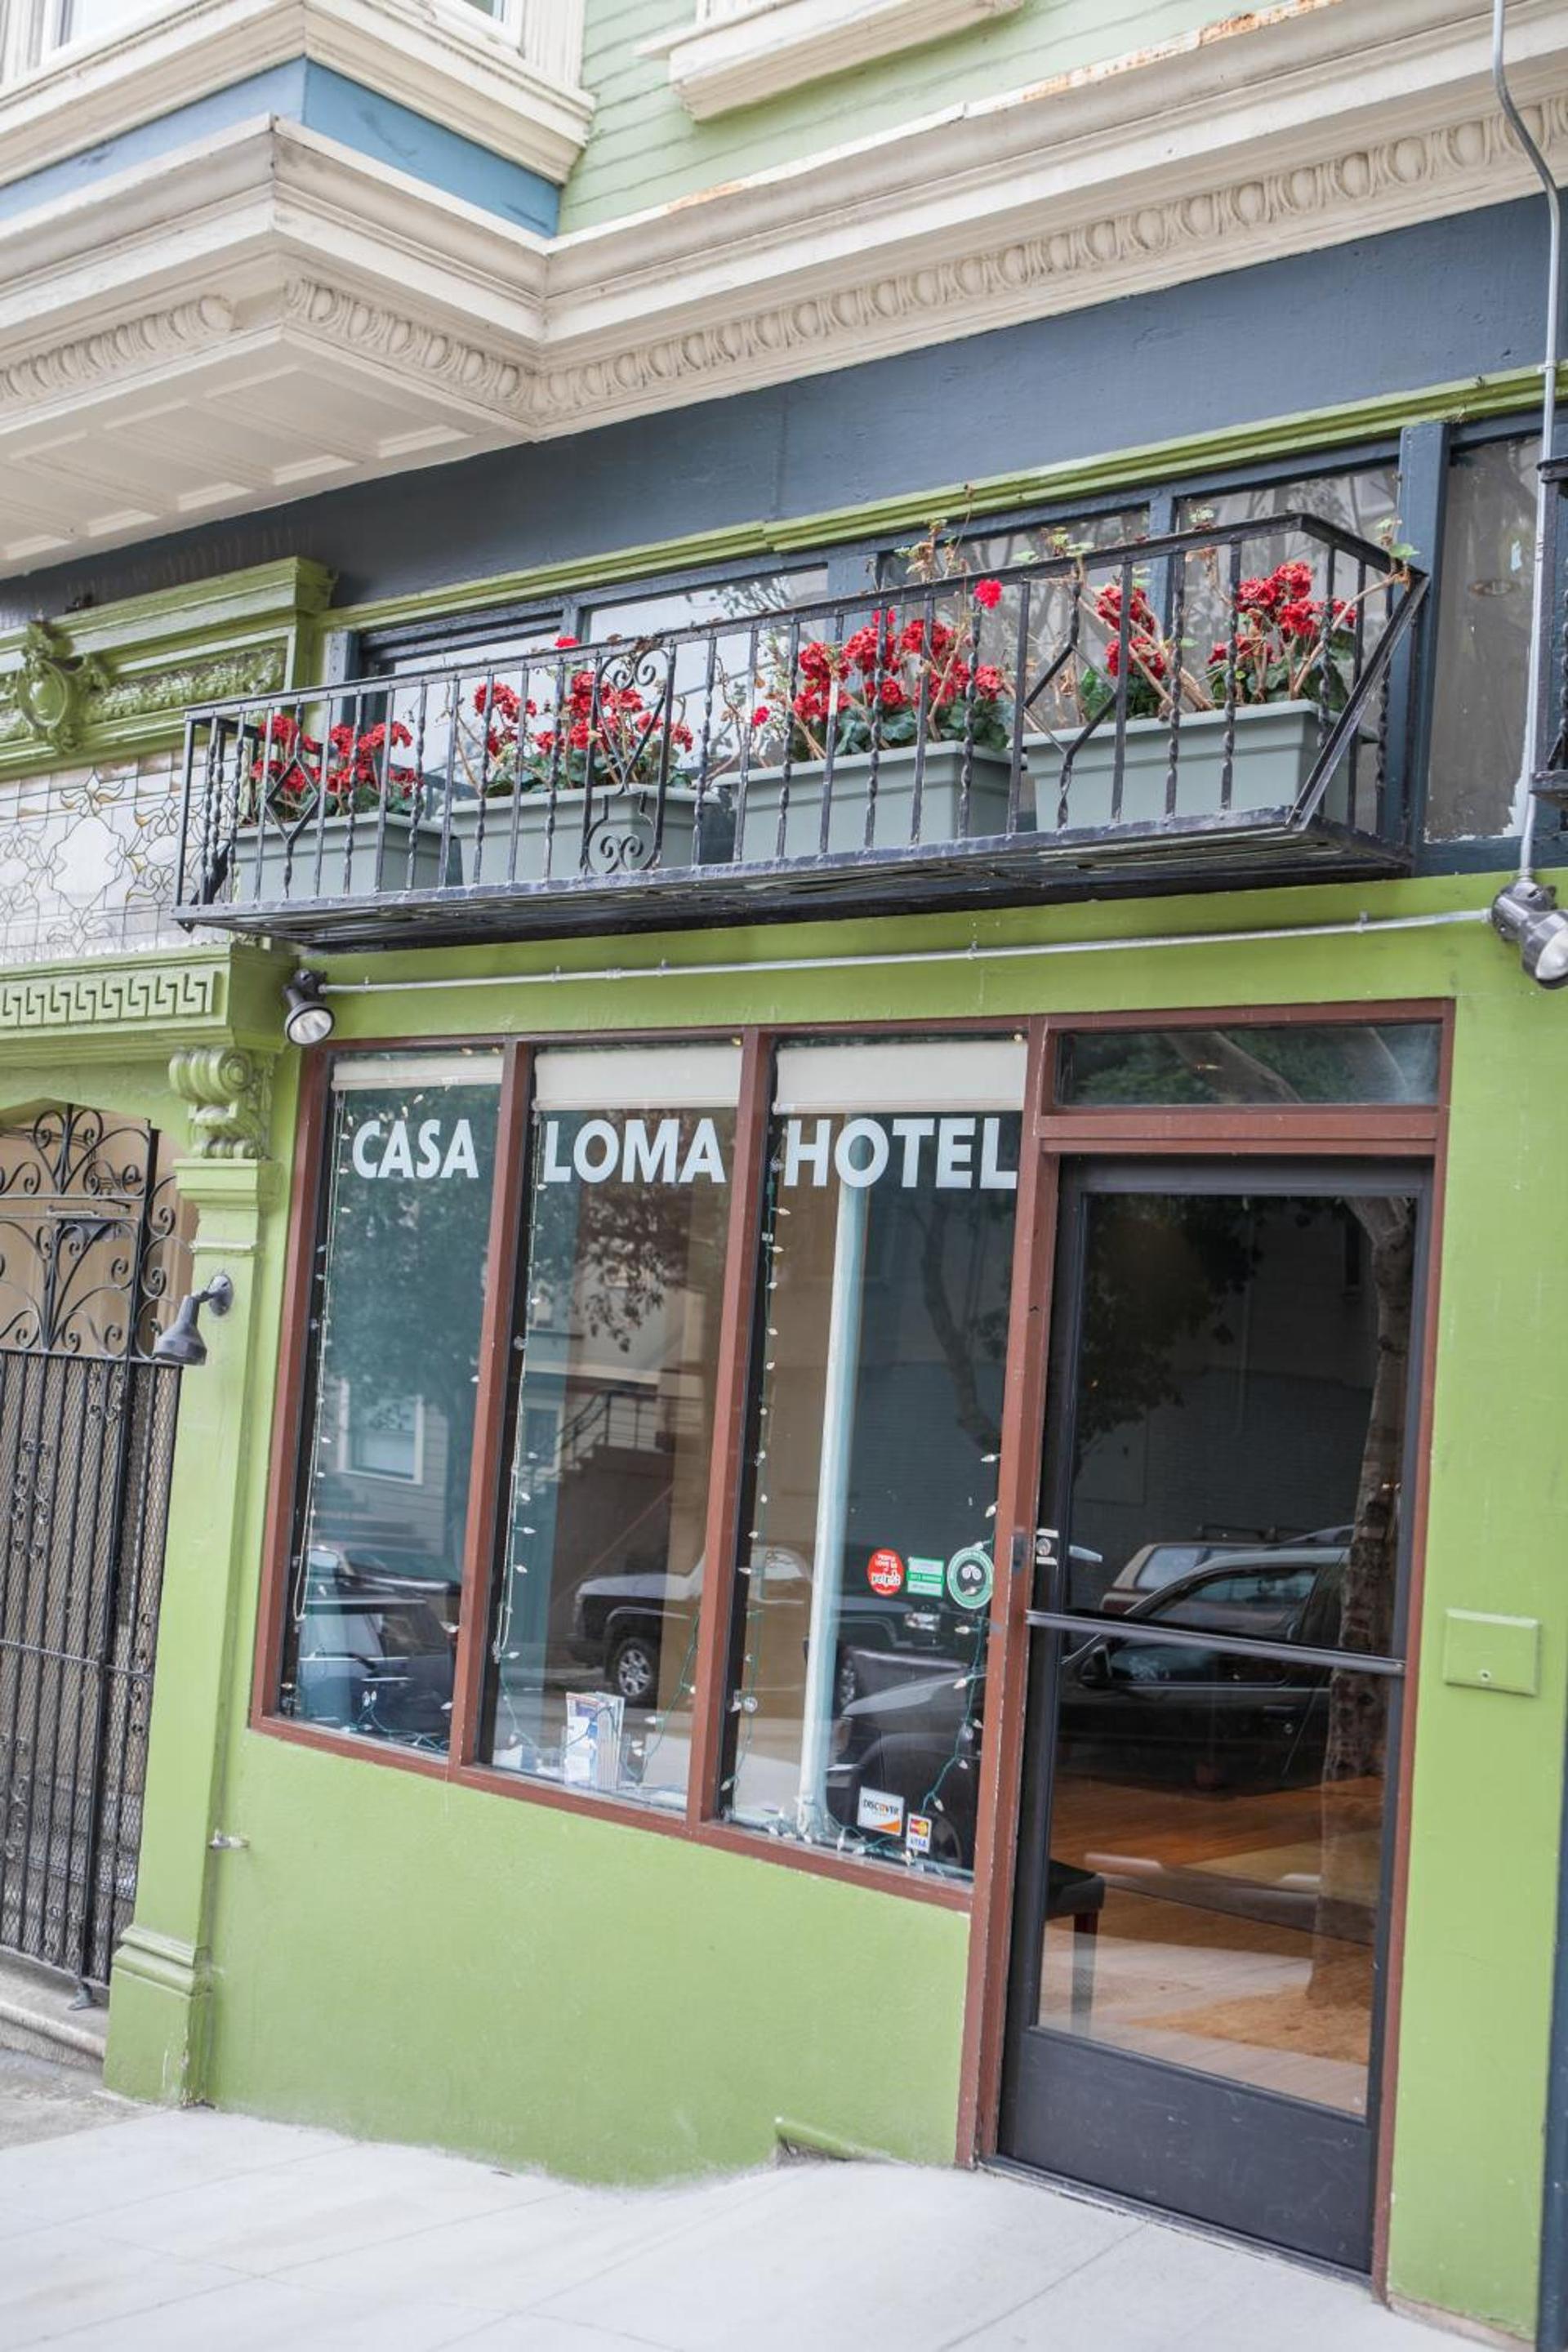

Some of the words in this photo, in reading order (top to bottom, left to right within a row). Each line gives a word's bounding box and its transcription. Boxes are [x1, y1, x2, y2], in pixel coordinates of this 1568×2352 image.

[352, 1119, 479, 1179] CASA
[543, 1118, 727, 1183] LOMA
[784, 1117, 1018, 1189] HOTEL
[863, 1798, 898, 1814] DISCOVER
